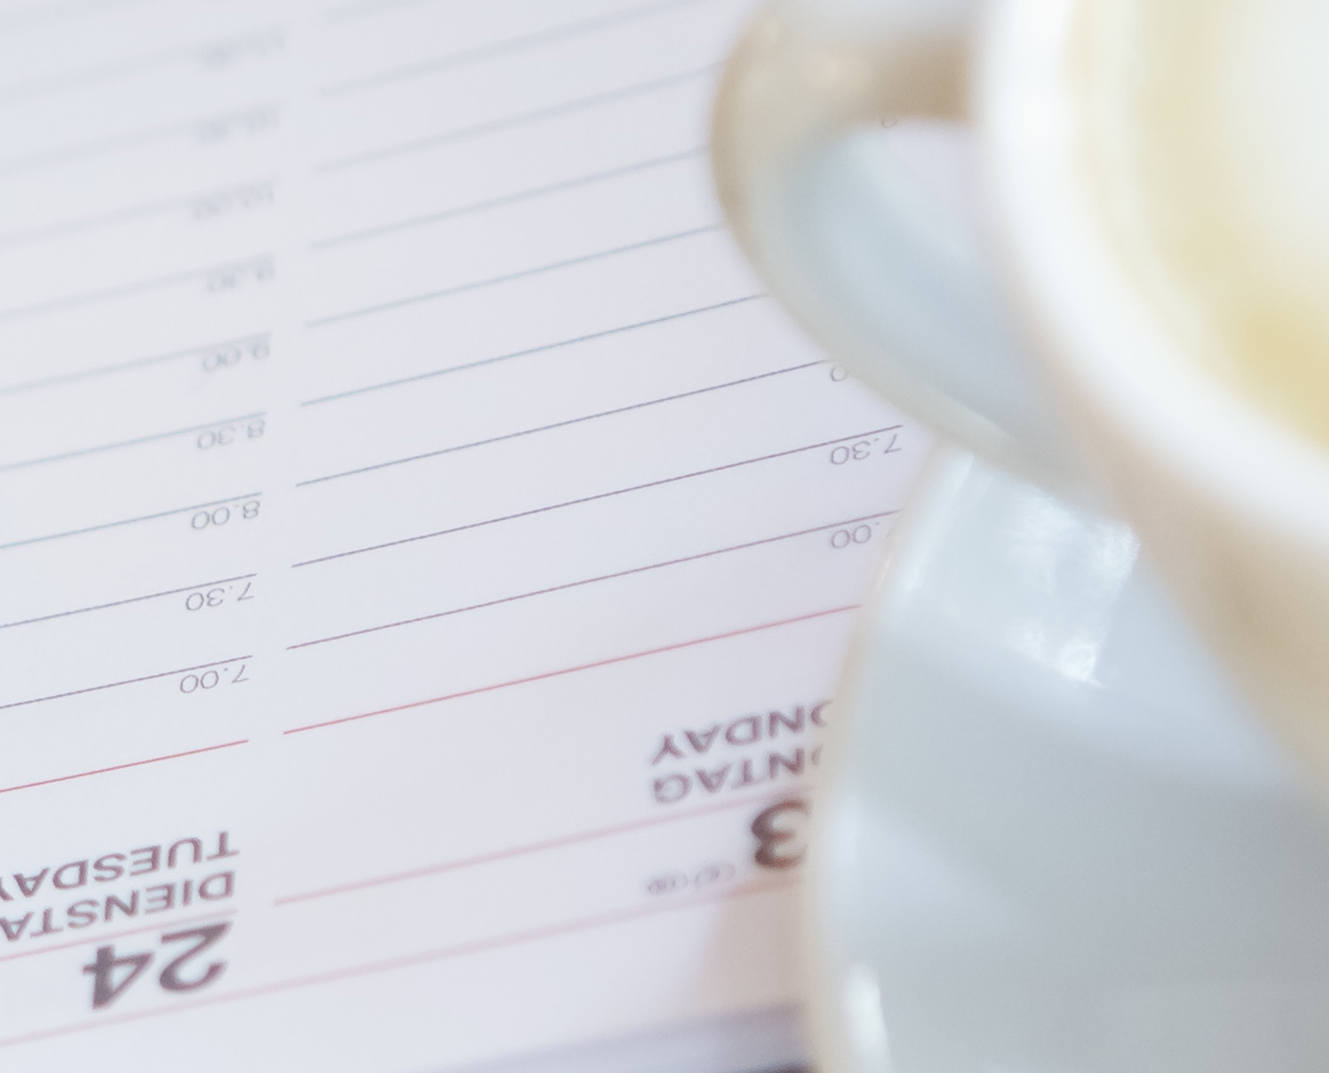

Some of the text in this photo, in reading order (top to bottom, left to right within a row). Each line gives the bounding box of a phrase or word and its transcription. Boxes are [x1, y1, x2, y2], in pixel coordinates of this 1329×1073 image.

[196, 419, 266, 450] 8.30
[830, 434, 901, 466] 7.30
[190, 500, 261, 530] 8.00
[830, 521, 883, 549] .00
[185, 581, 255, 612] 7.30
[179, 664, 250, 694] 7.00
[649, 700, 831, 766] NDAY
[652, 746, 823, 804] NTAG
[751, 798, 807, 873] 3
[82, 921, 233, 1011] 24
